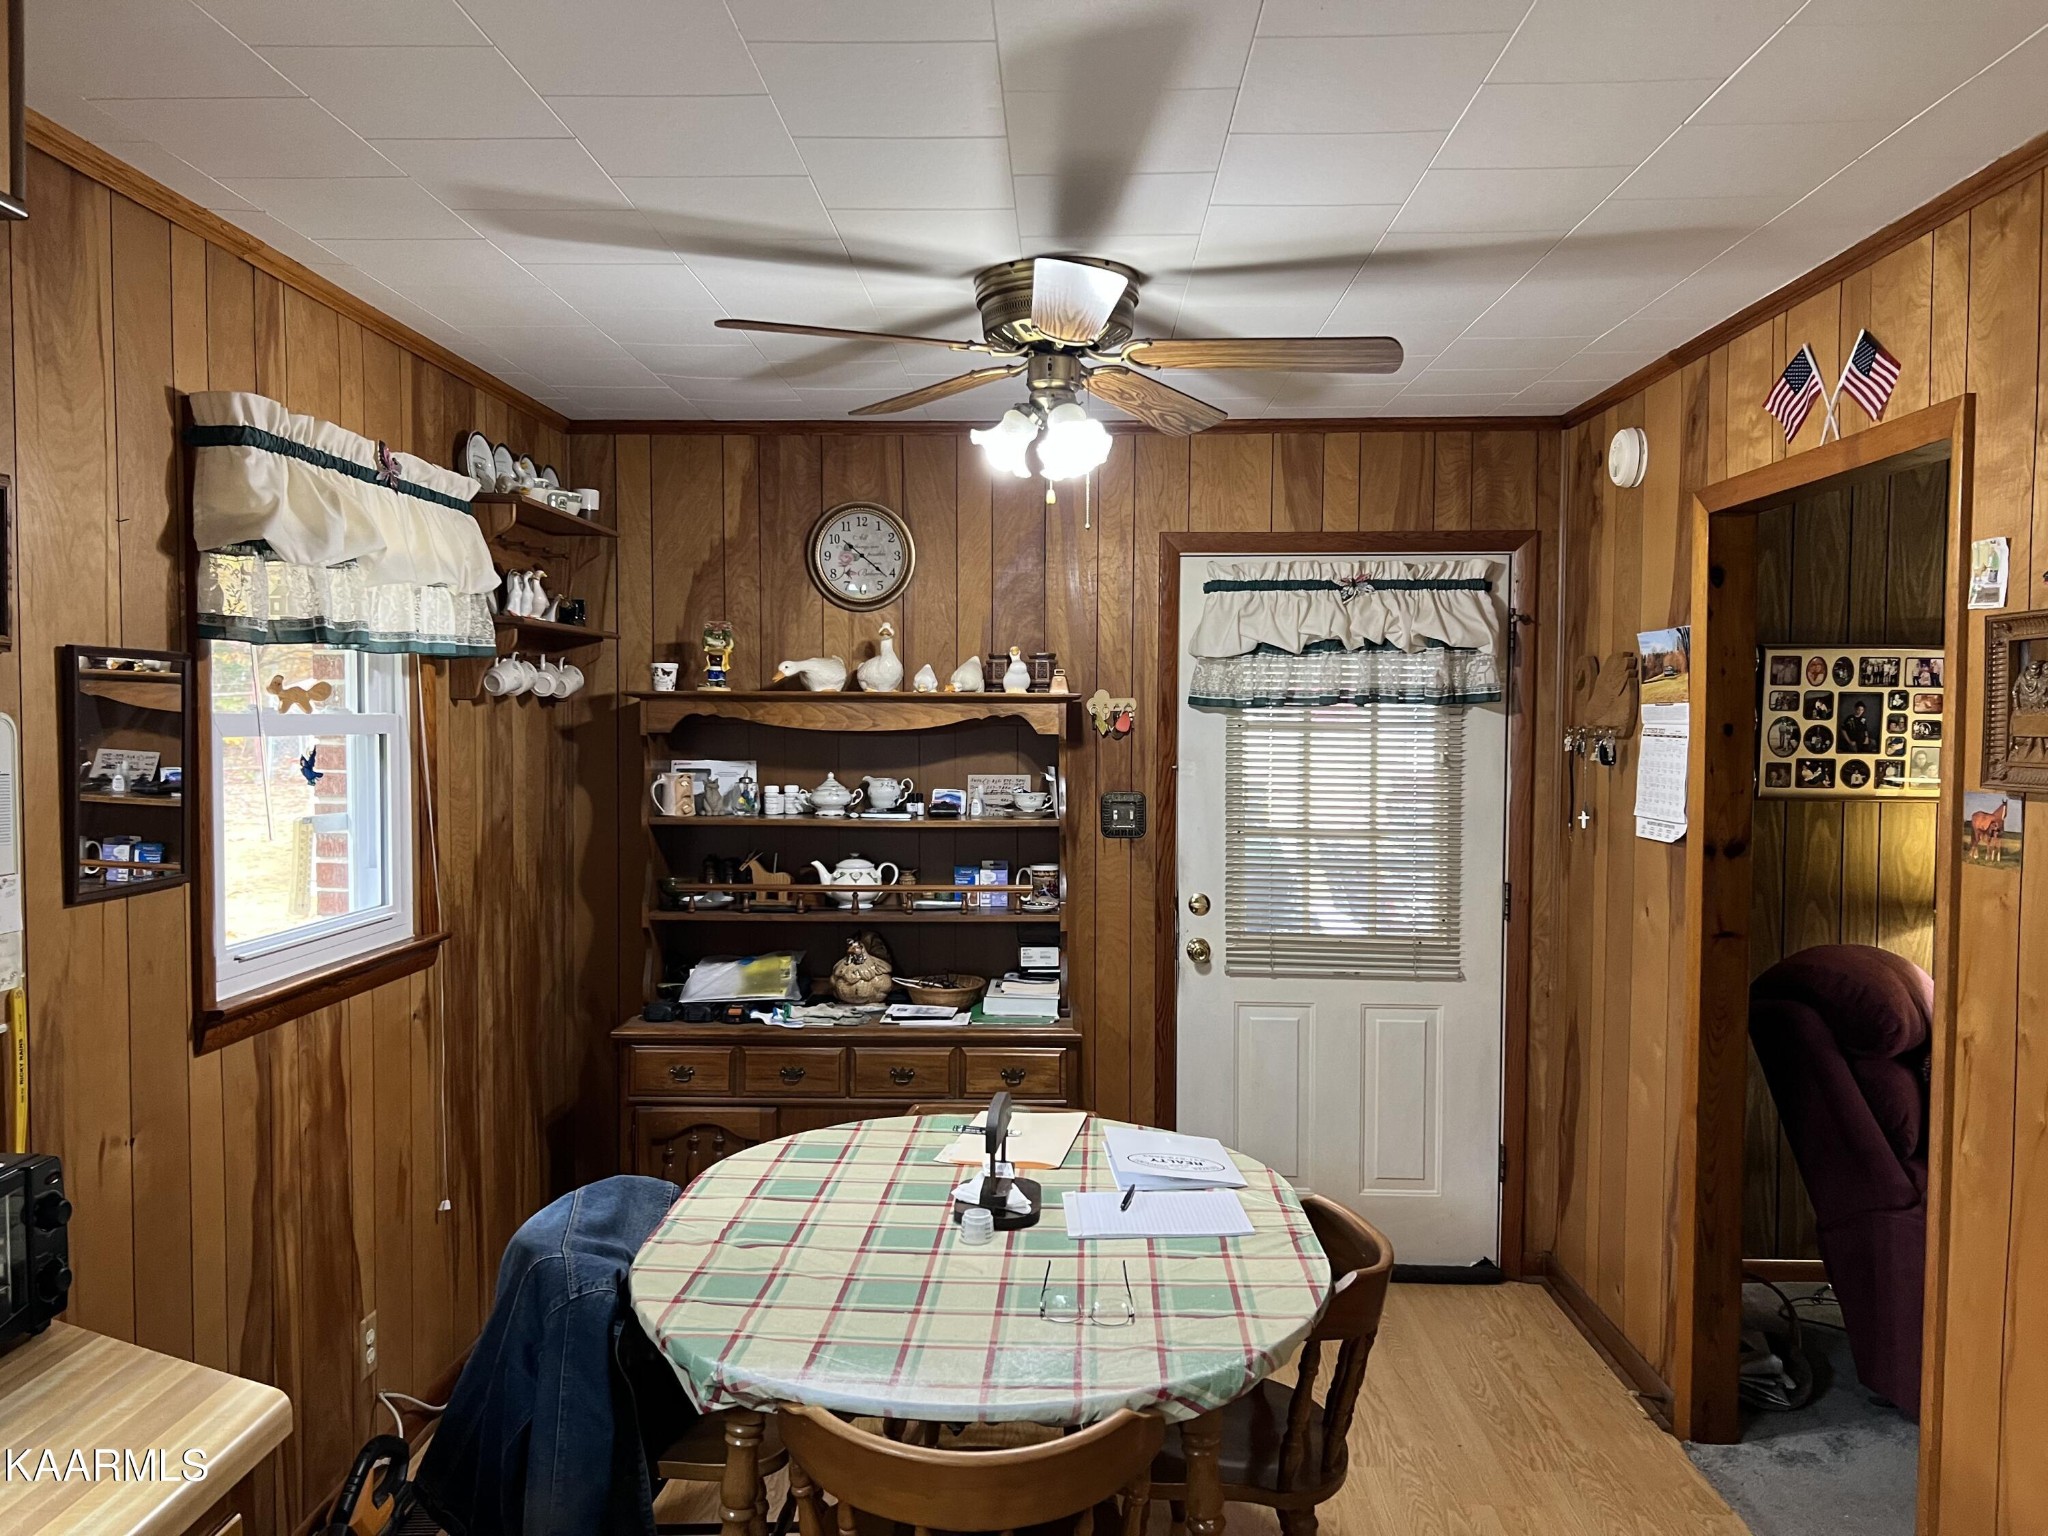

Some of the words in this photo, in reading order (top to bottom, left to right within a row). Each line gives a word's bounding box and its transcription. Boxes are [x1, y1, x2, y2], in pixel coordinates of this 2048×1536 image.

[856, 516, 868, 526] 12
[876, 521, 881, 531] 1
[842, 522, 850, 531] 11
[830, 534, 840, 544] 10
[888, 533, 895, 542] 2
[824, 551, 831, 560] 9
[894, 551, 901, 561] 3
[830, 569, 837, 578] 8
[889, 568, 896, 578] 4
[843, 581, 850, 591] 7
[877, 581, 883, 591] 5
[1151, 1158, 1203, 1166] REALTY
